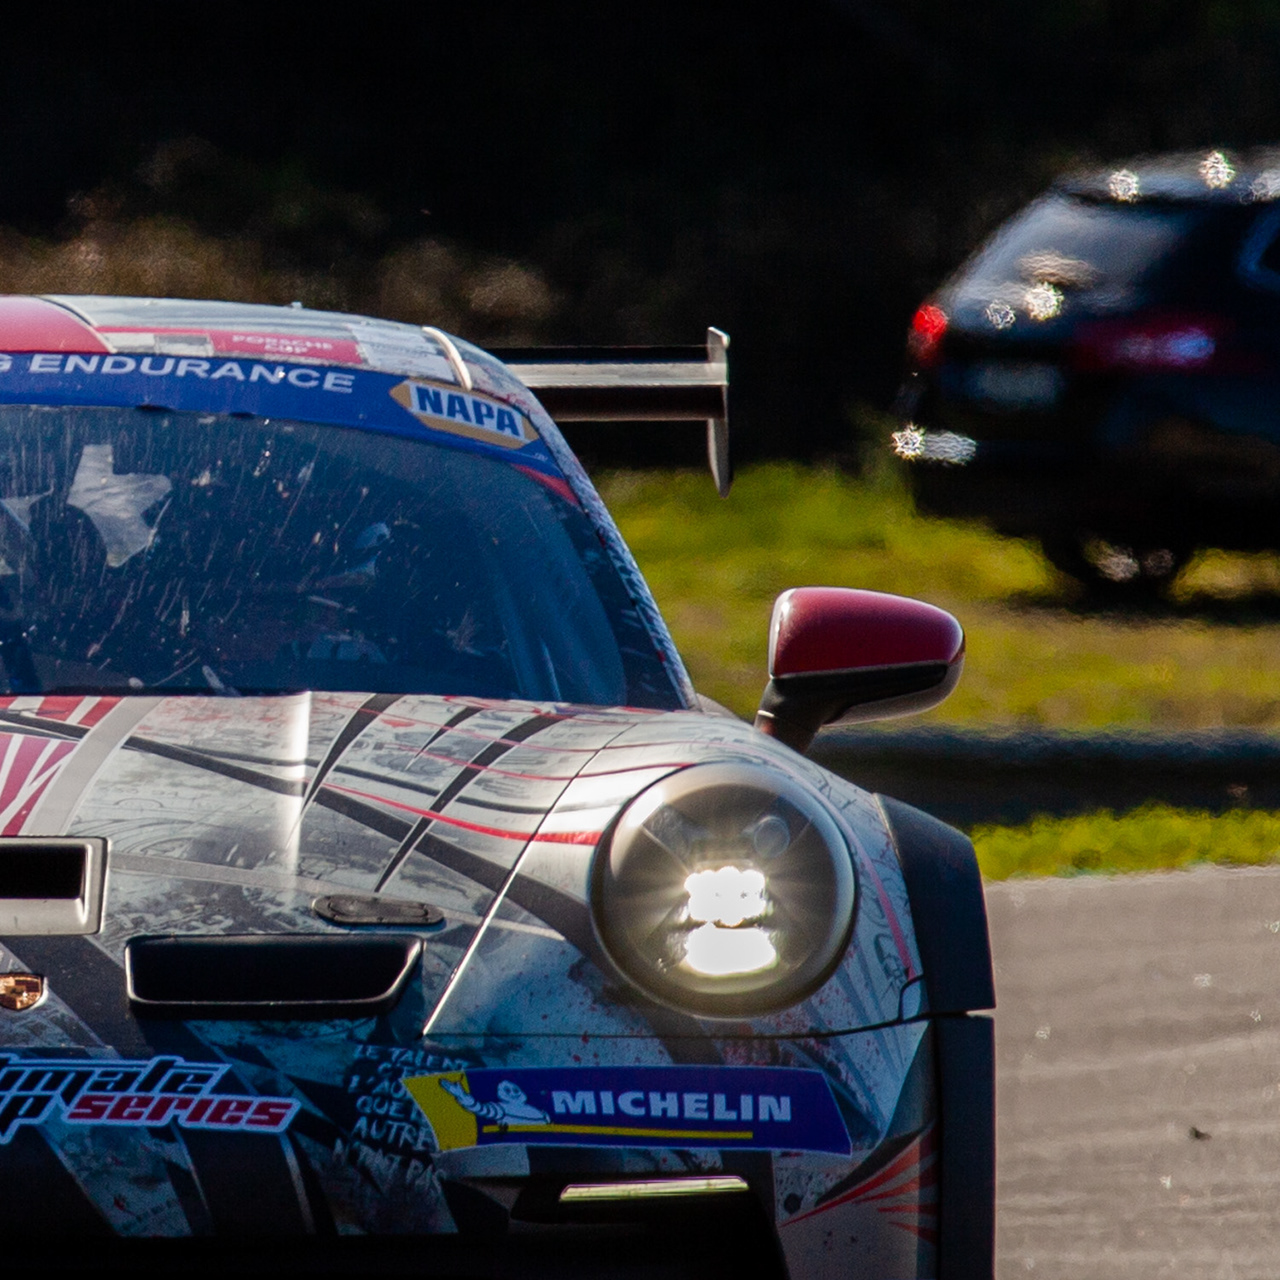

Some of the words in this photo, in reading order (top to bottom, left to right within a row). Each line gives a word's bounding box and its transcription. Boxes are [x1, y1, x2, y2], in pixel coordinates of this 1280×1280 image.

[231, 334, 333, 351] PORSCHE
[28, 353, 355, 394] ENDURANCE
[415, 386, 521, 437] NAPA
[551, 1090, 791, 1121] MICHELIN
